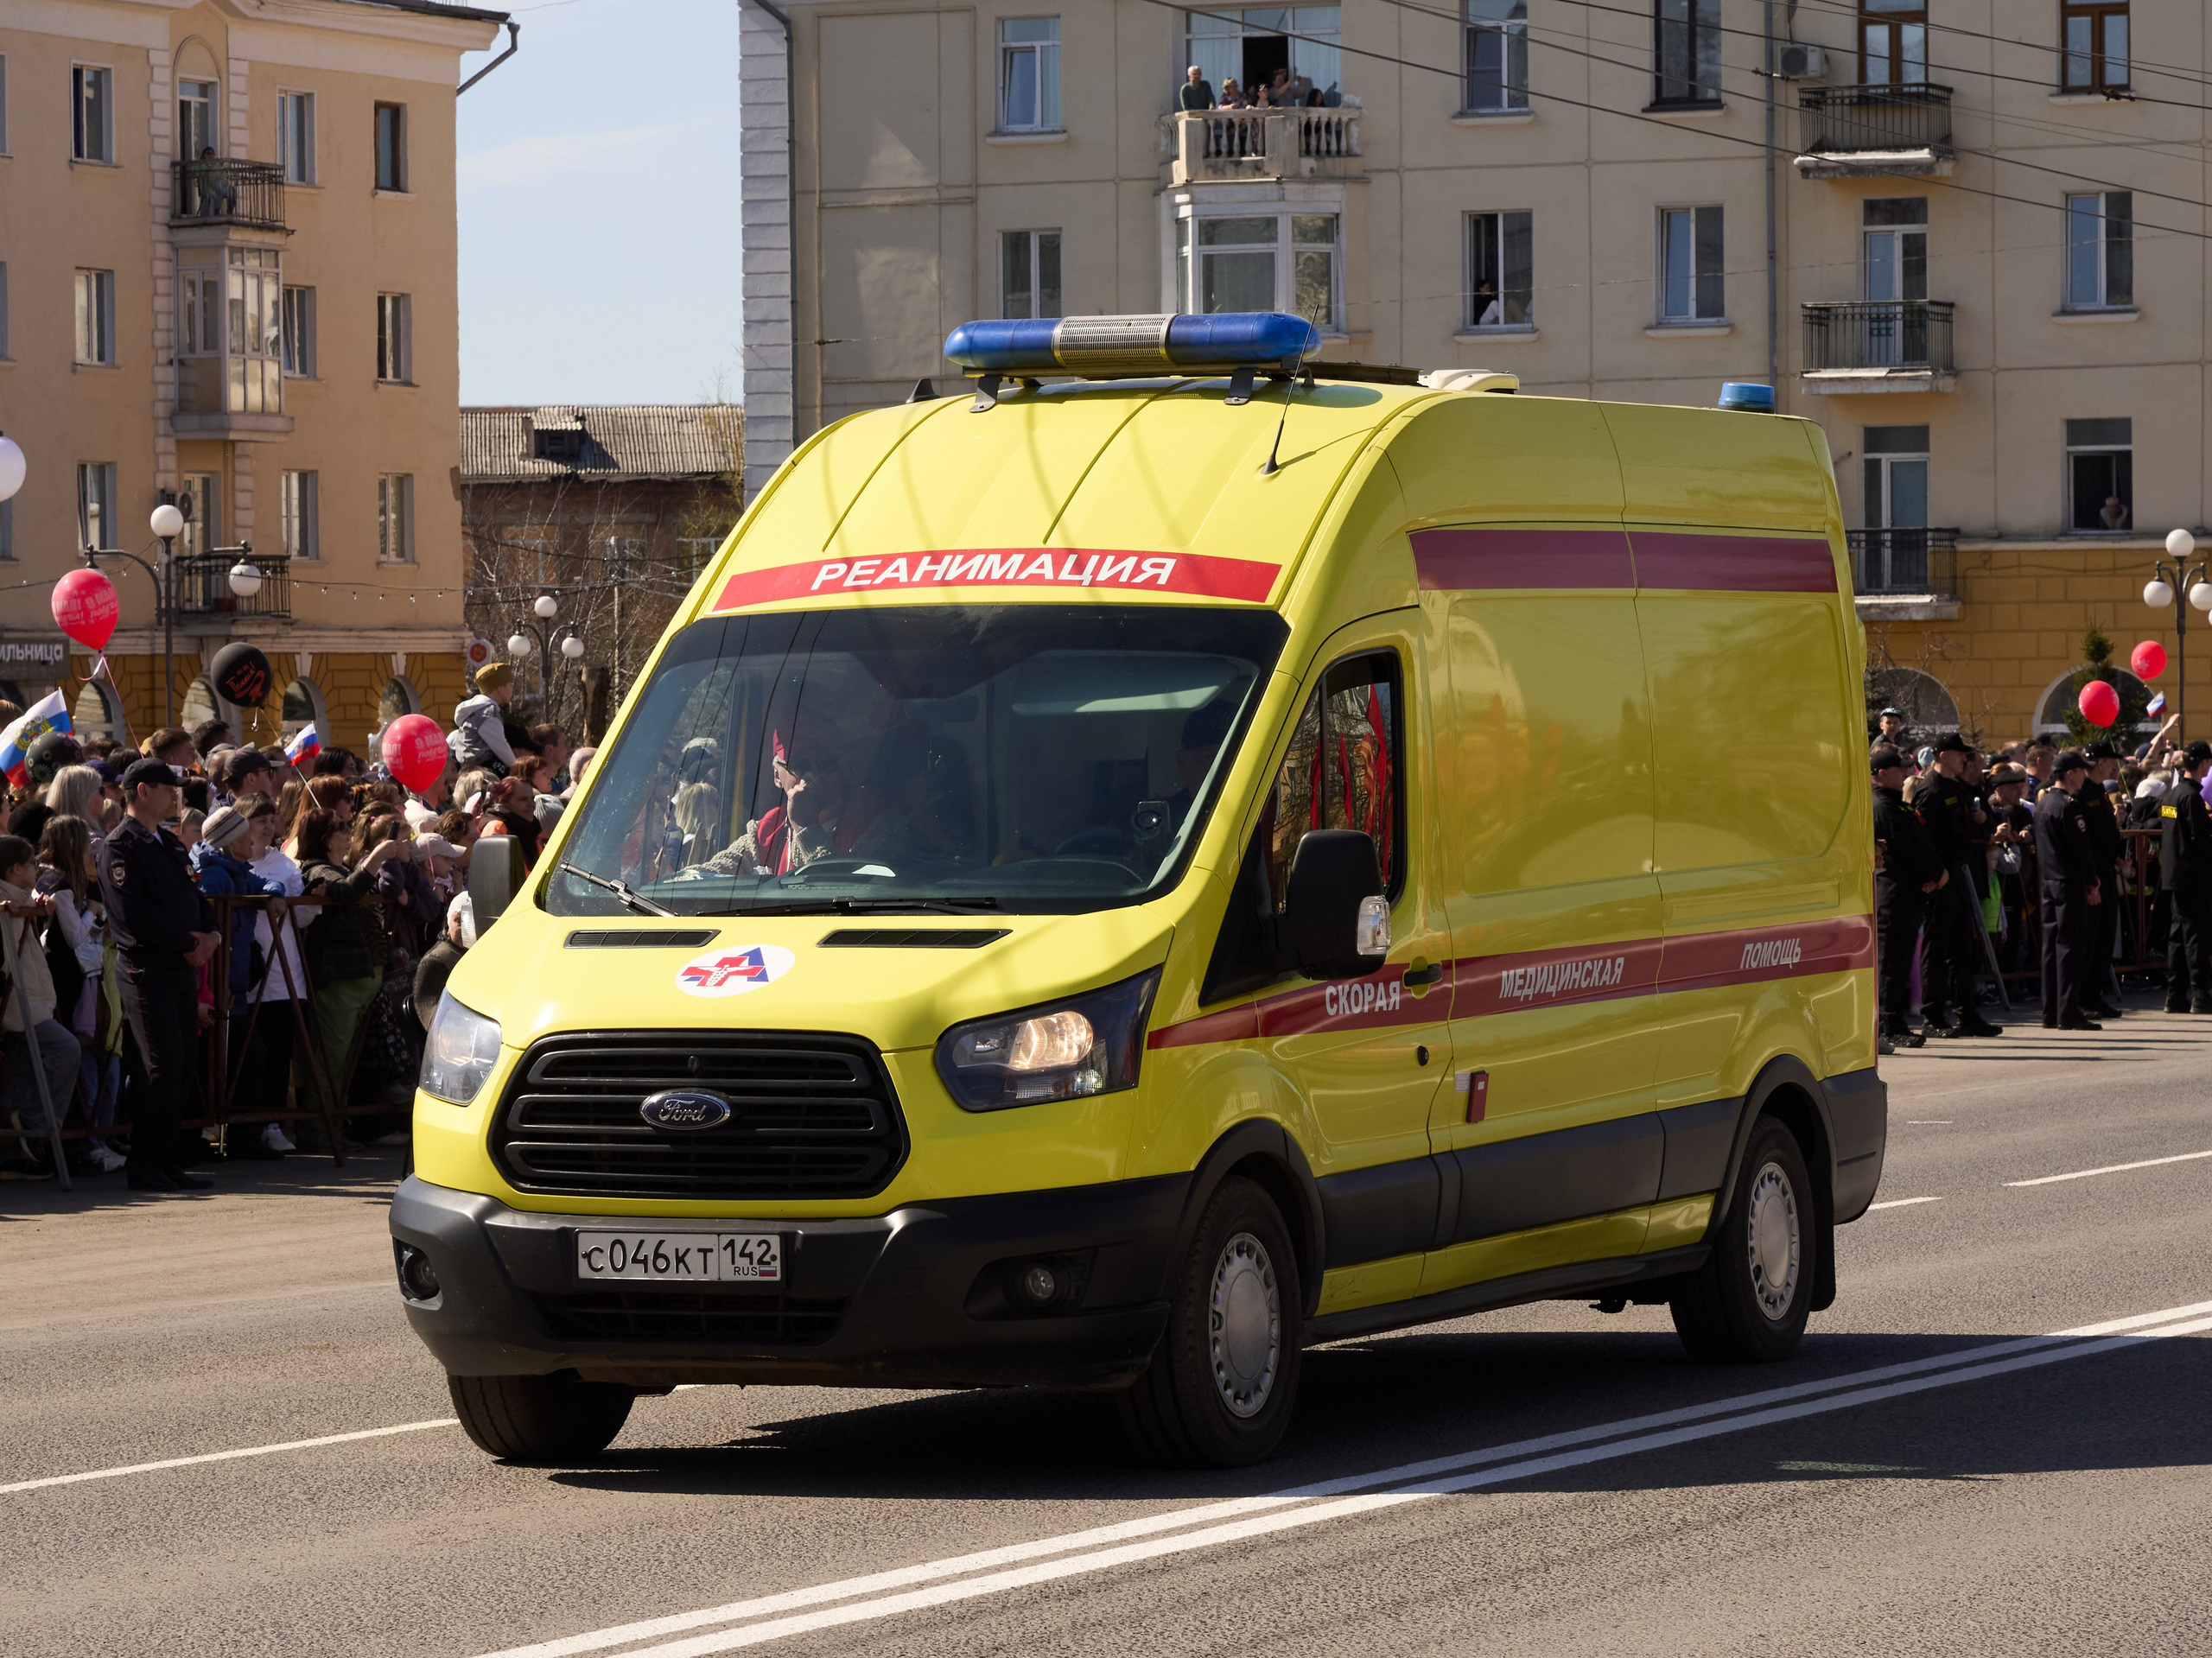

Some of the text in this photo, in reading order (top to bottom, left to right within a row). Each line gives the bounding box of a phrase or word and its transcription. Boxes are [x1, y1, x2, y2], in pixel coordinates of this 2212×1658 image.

[810, 554, 1177, 590] РЕАНИМАЦИЯ
[1325, 938, 1802, 1015] СКОРАЯ МЕДИЦИНСКАЯ ПОМОЩЬ
[658, 1098, 707, 1121] Ford
[722, 1239, 772, 1266] 142
[734, 1267, 758, 1276] RUS
